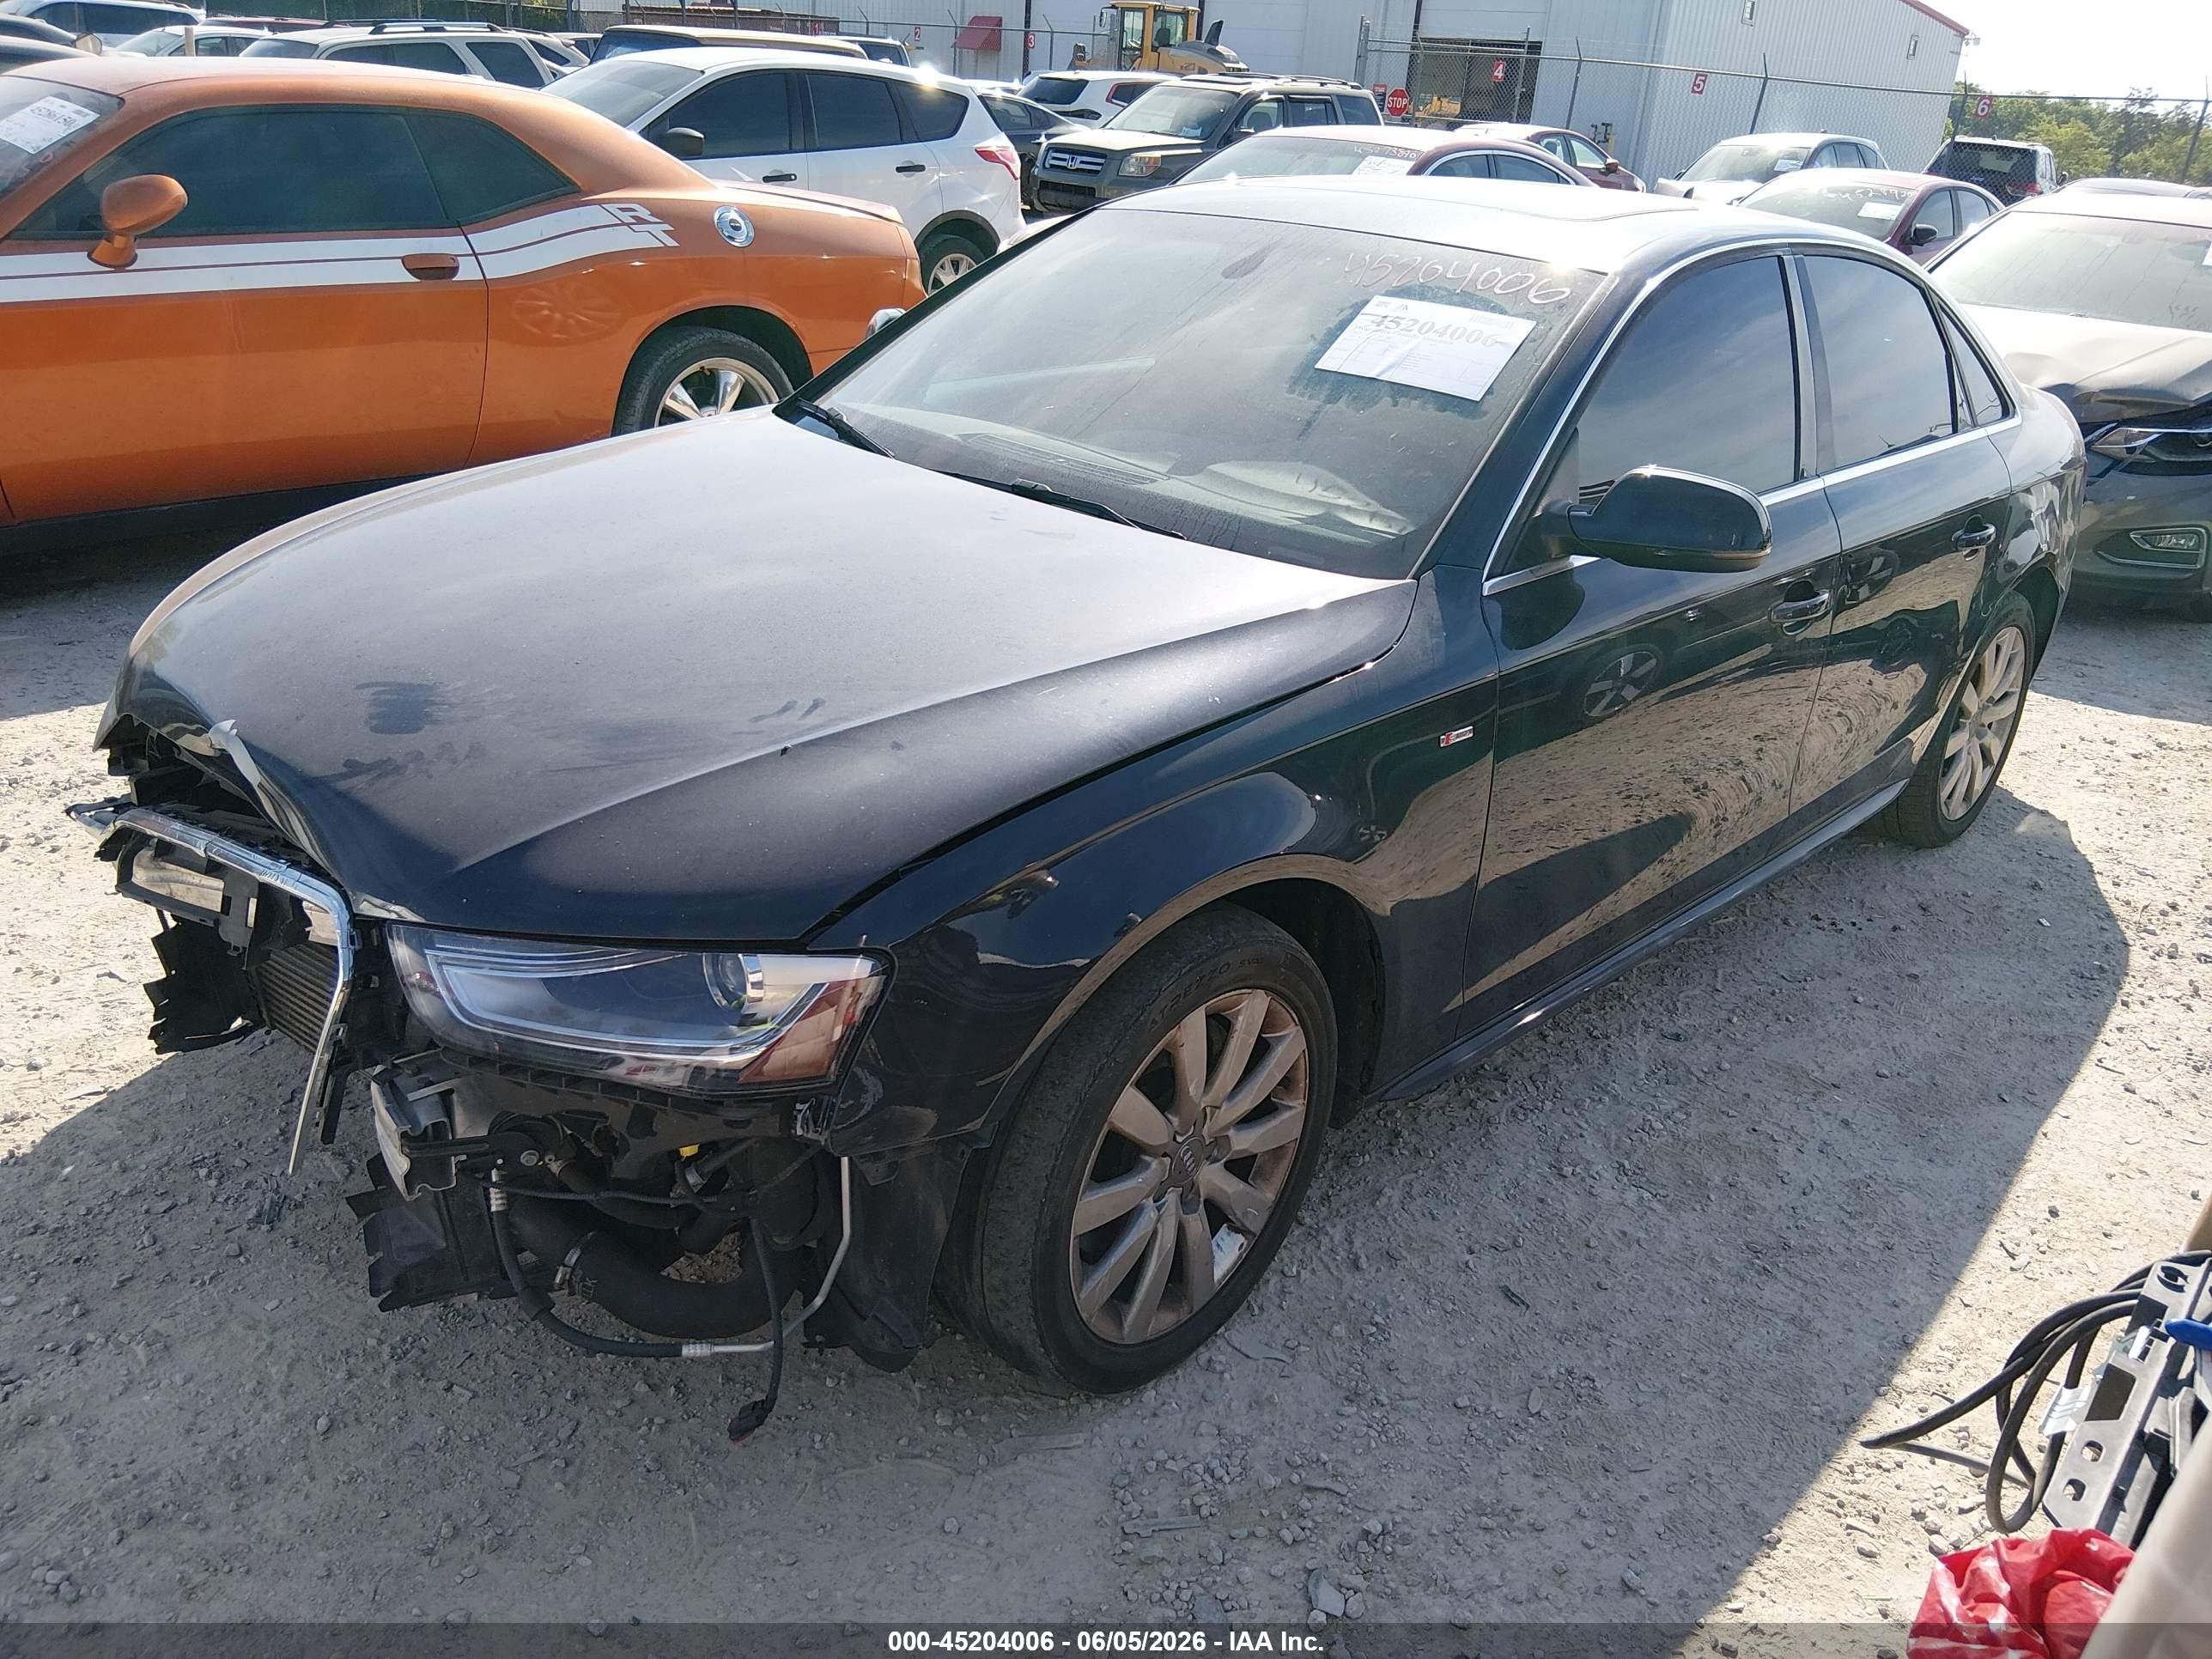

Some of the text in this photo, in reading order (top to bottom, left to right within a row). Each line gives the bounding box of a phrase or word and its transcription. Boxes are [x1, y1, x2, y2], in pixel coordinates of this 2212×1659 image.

[914, 28, 921, 41] 2
[1028, 34, 1035, 47] 3
[1494, 63, 1503, 79] 4
[1693, 76, 1705, 92] 5
[1388, 96, 1407, 109] STOP
[1978, 99, 1990, 116] 6
[1344, 253, 1571, 304] 45204006
[1370, 314, 1497, 348] 45204006
